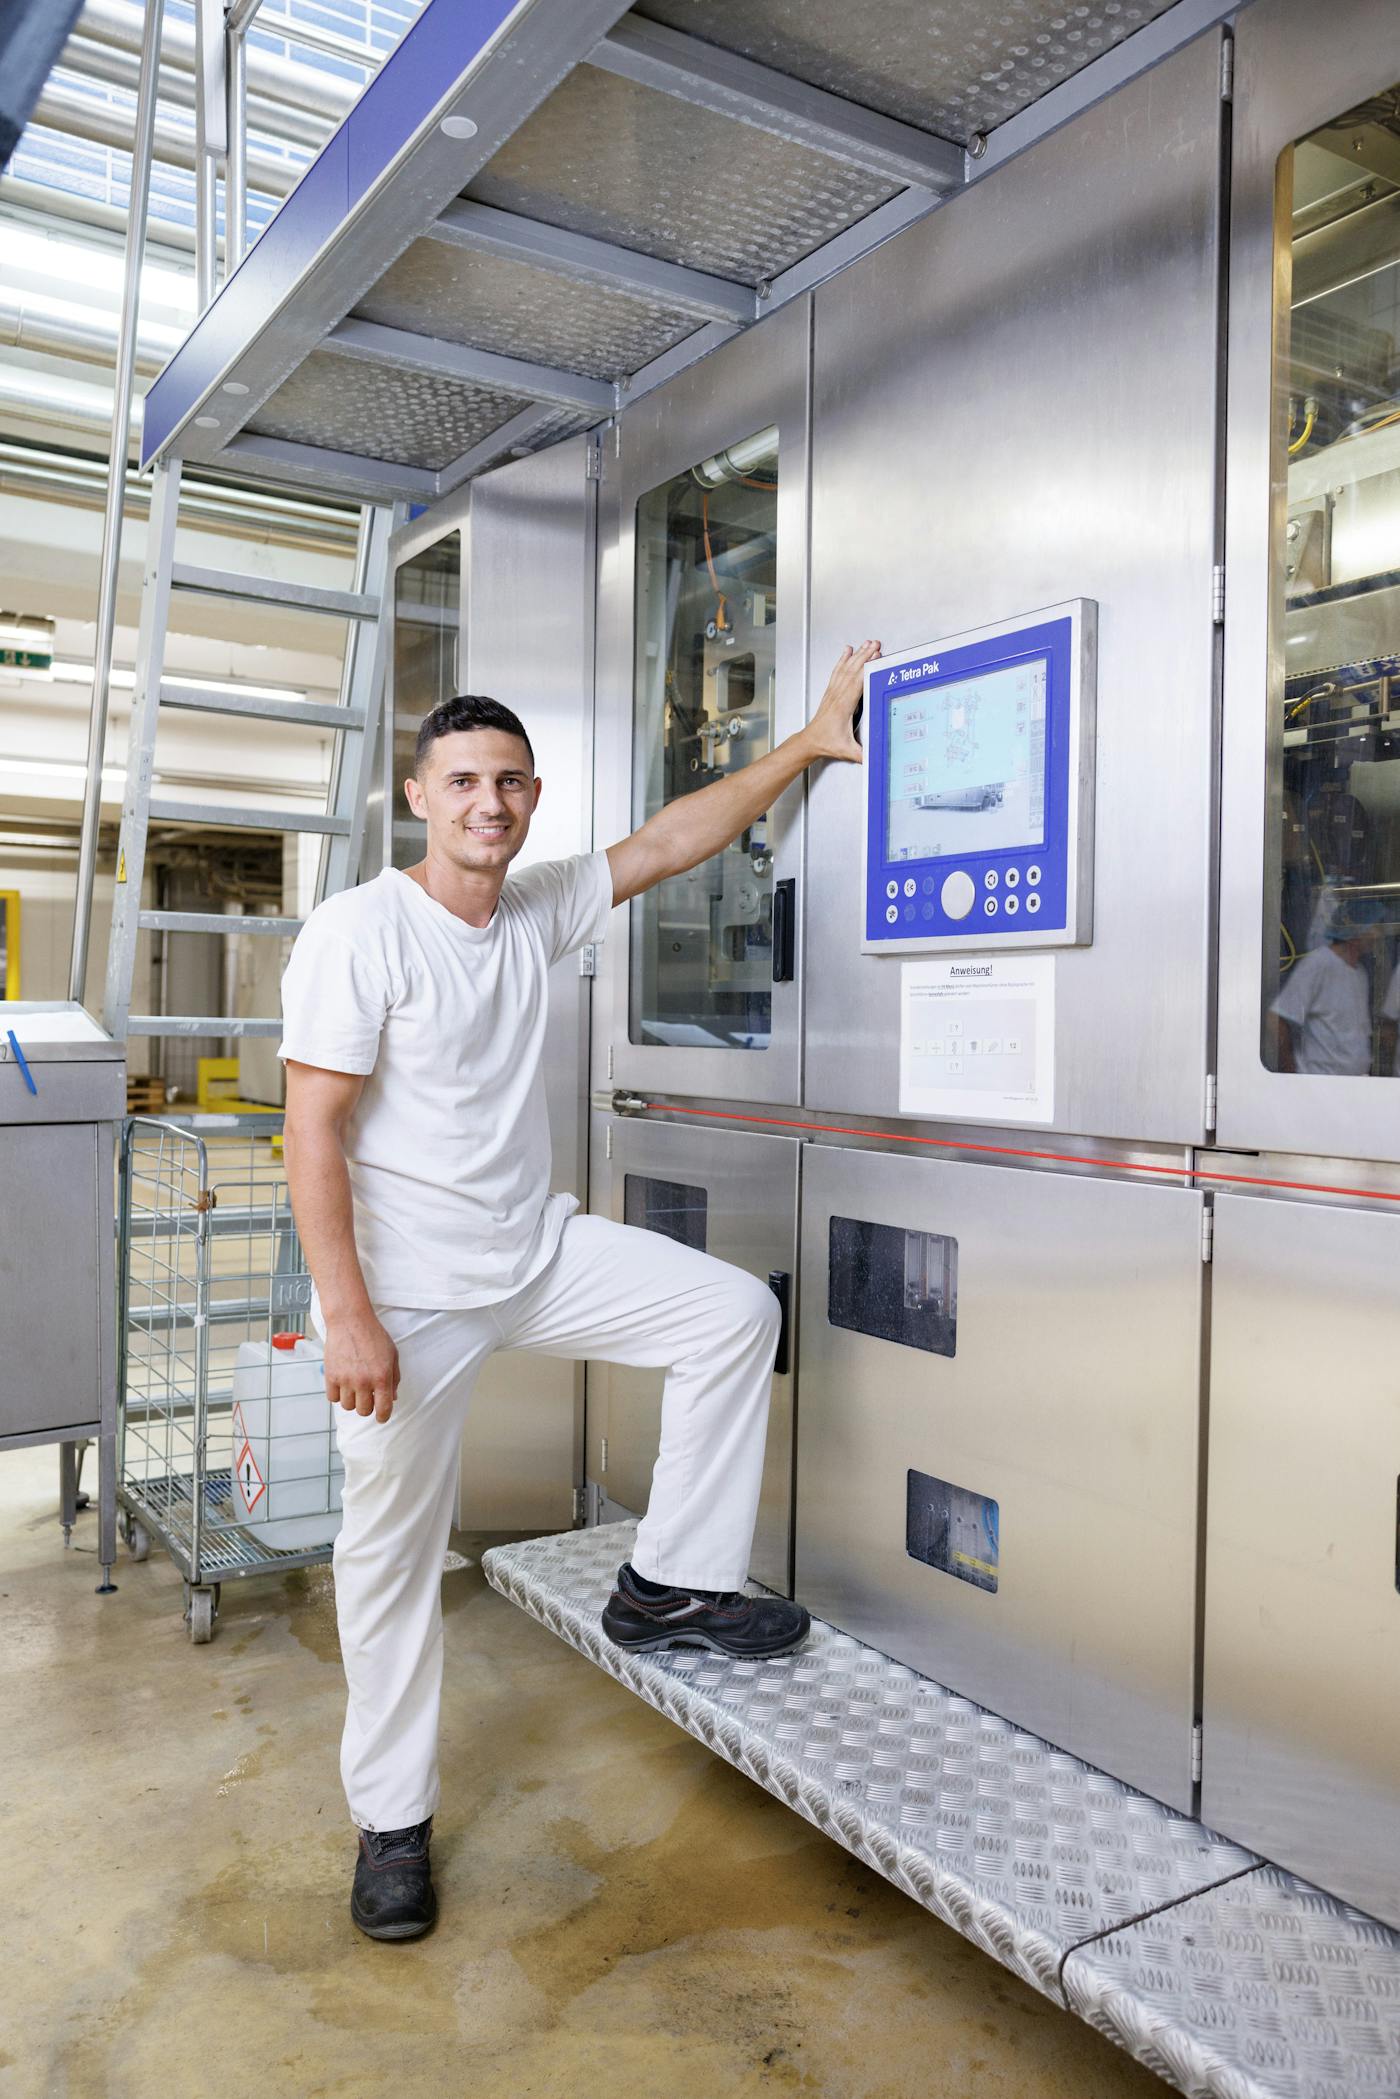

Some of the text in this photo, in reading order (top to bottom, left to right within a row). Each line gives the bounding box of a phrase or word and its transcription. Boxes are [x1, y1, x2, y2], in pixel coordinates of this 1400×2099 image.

[900, 661, 940, 682] Tetra Pak
[950, 965, 993, 977] Anweisung!
